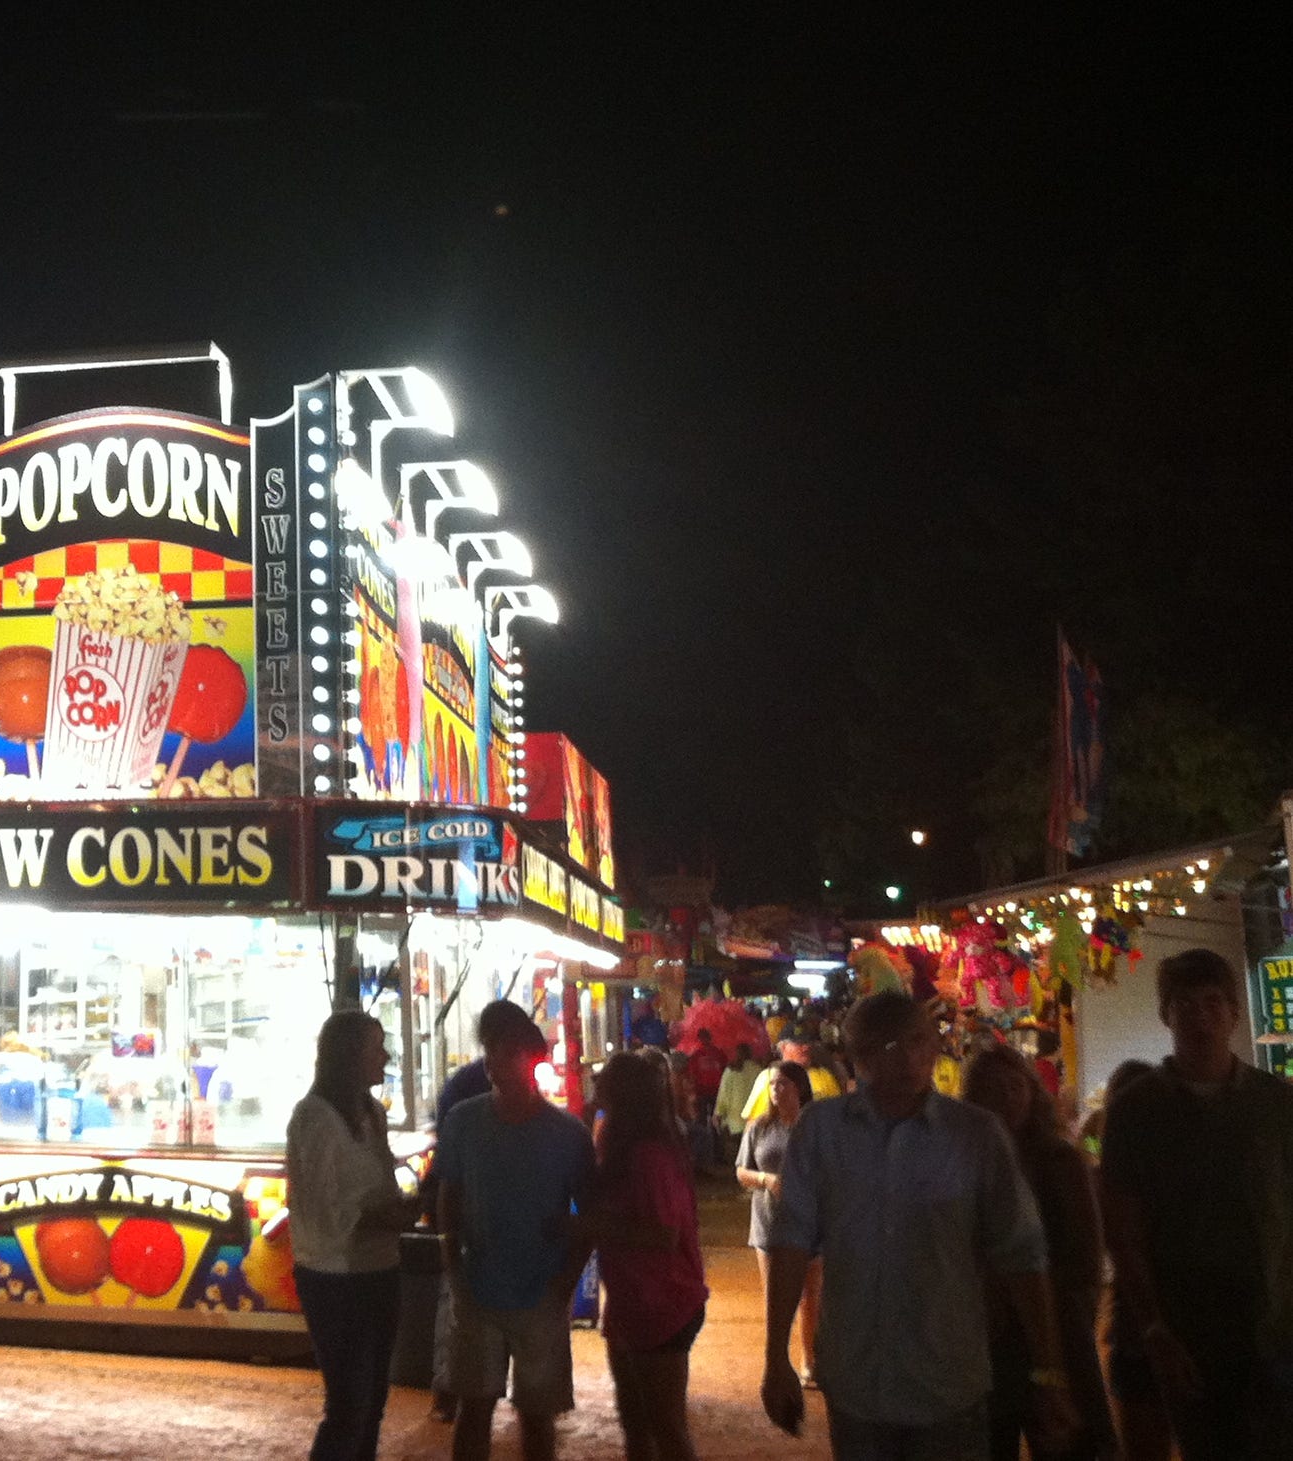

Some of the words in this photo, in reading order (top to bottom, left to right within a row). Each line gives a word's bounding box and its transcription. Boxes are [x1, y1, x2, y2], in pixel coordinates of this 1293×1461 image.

[262, 467, 291, 742] SWEETS
[64, 669, 107, 702] POP
[66, 699, 121, 731] CORN
[372, 828, 420, 848] ICE
[427, 821, 488, 841] COLD
[66, 826, 274, 887] CONES
[326, 854, 520, 906] DRINKS
[1265, 960, 1293, 980] RU
[109, 1173, 233, 1222] APPLES
